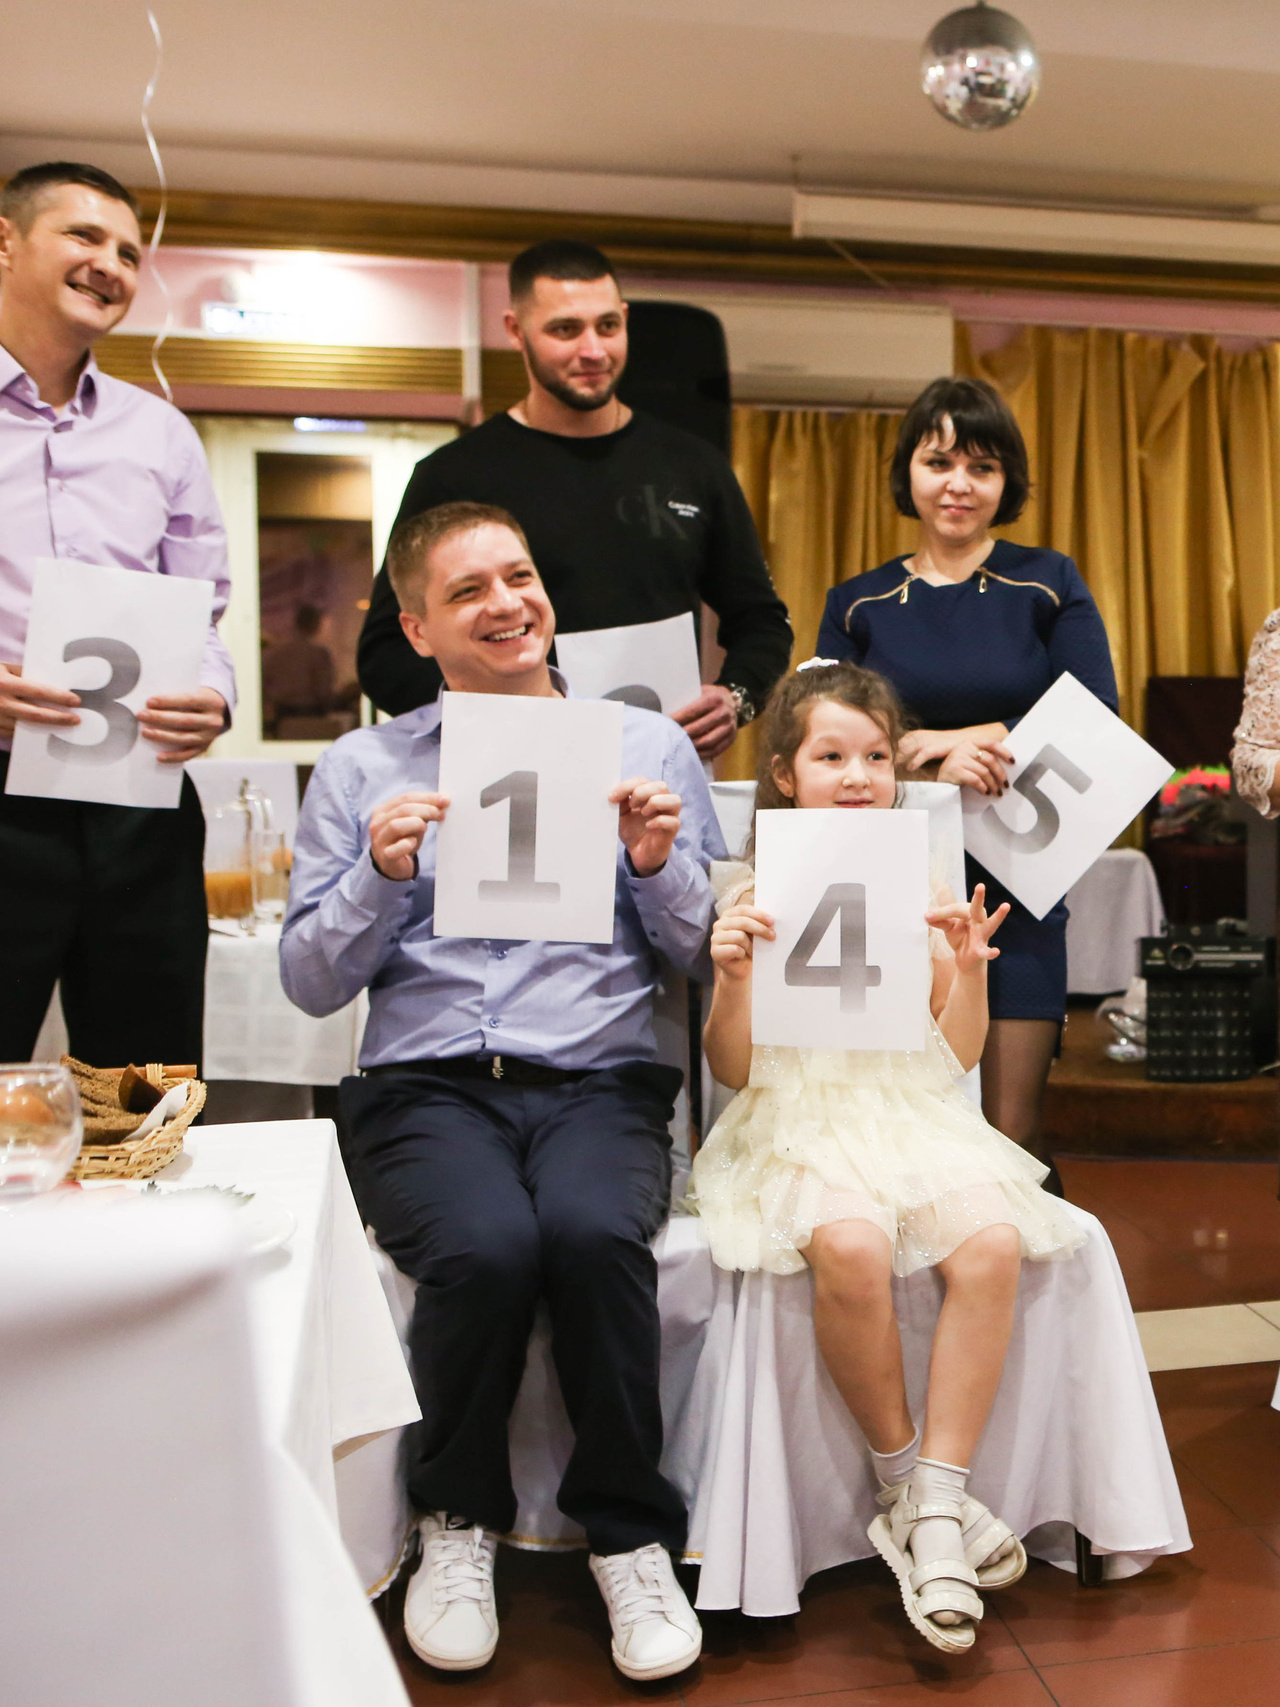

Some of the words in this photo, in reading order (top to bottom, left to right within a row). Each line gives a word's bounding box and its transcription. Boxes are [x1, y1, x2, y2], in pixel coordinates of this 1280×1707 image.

[47, 636, 142, 767] 3
[478, 770, 561, 903] 1
[981, 743, 1093, 855] 5
[784, 882, 882, 1014] 4
